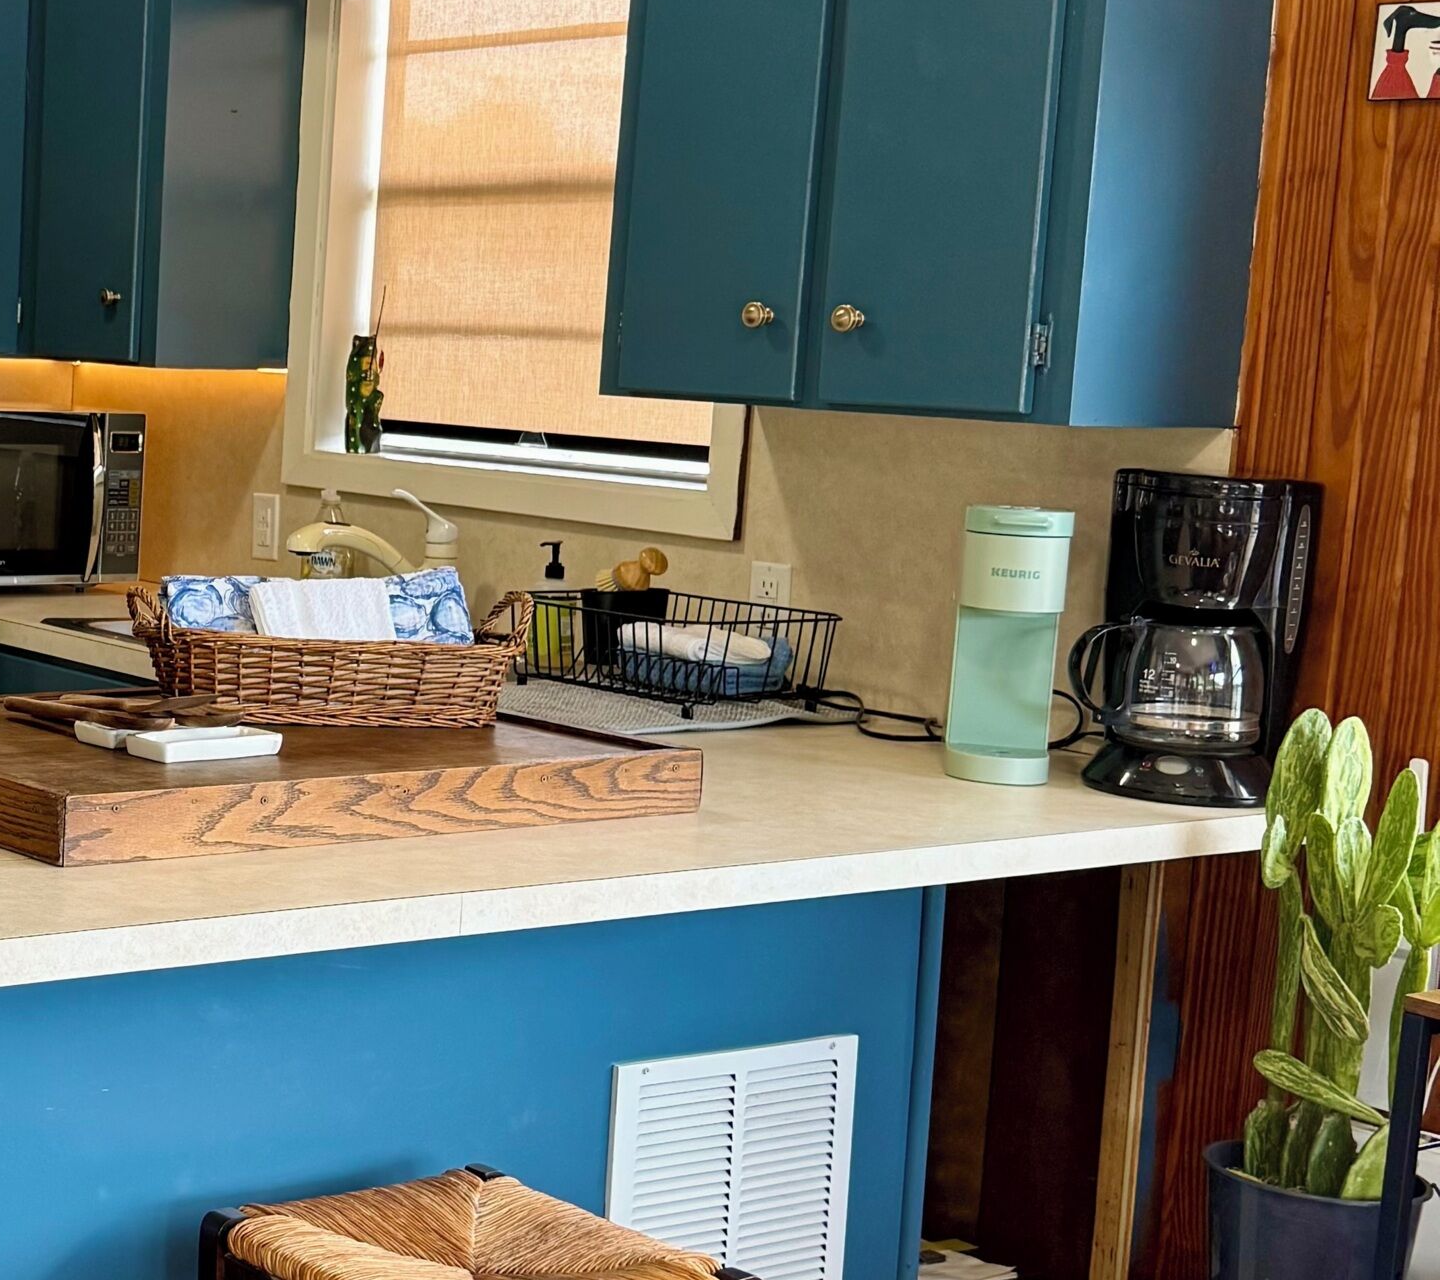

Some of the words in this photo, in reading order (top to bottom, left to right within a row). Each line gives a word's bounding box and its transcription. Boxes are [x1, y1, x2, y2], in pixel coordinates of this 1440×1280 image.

[311, 555, 336, 568] DAWN
[1168, 554, 1220, 568] GEVALIA
[991, 567, 1041, 580] KEURIG
[1143, 668, 1156, 680] 12
